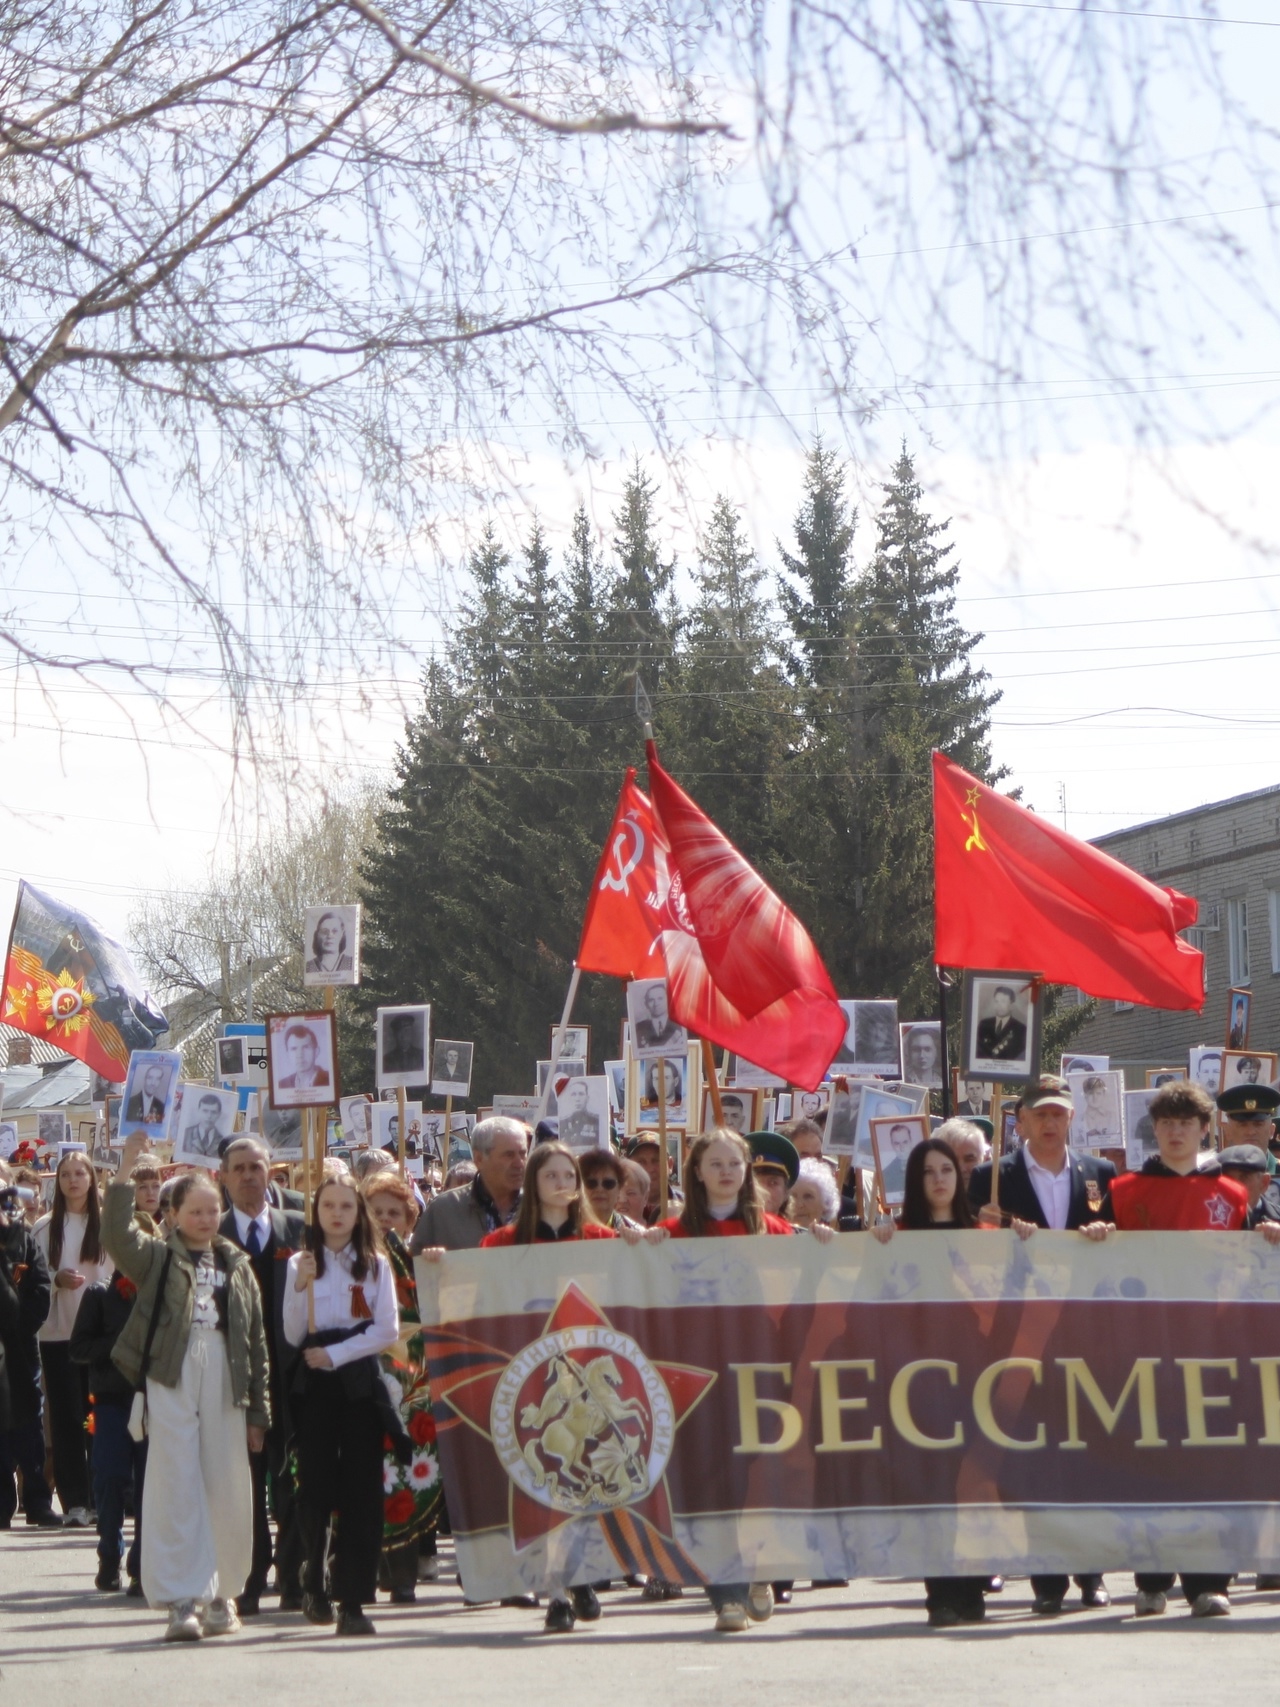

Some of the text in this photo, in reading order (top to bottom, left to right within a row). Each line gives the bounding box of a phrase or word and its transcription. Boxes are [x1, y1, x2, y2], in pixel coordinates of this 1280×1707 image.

[495, 1329, 671, 1465] БЕССМЕРТНЫЙ ПОЛК РОССИИ
